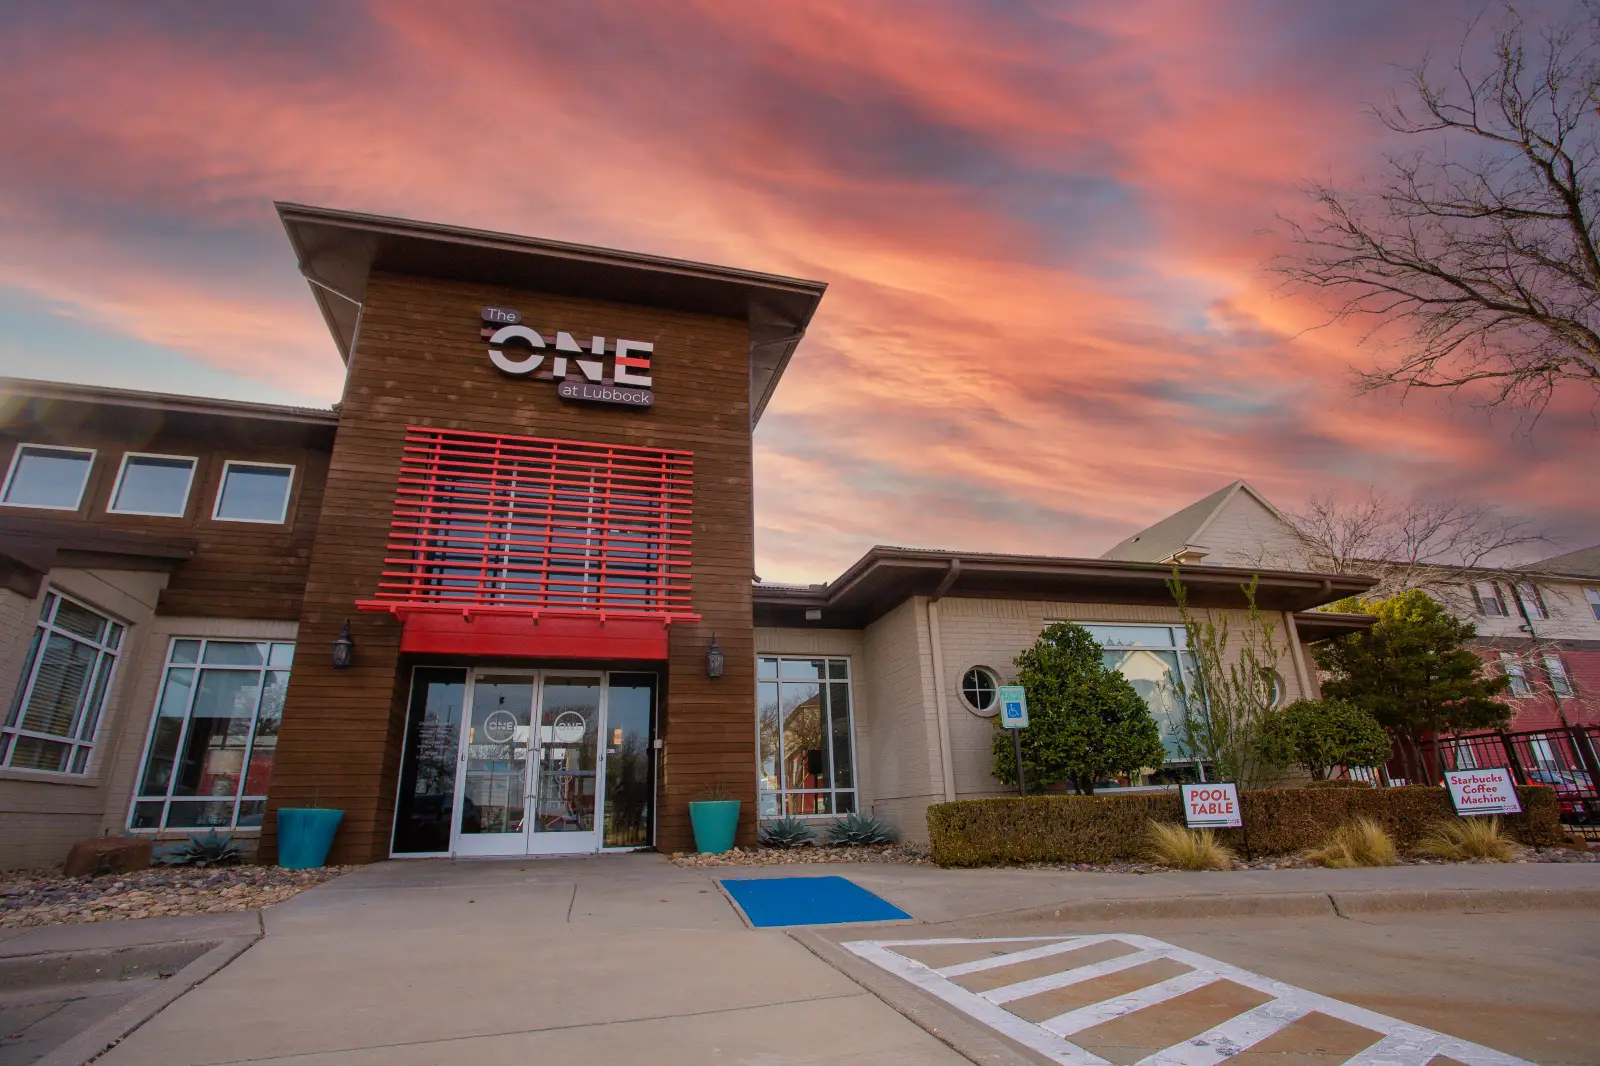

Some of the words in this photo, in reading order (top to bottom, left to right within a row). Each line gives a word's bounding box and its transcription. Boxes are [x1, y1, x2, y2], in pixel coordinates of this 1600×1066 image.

[487, 308, 516, 322] The
[488, 325, 654, 387] ONE
[562, 385, 578, 397] at
[583, 386, 650, 404] Lubbock
[489, 720, 514, 731] ONE
[558, 722, 582, 731] ONE
[1450, 774, 1503, 785] Starbucks
[1462, 784, 1498, 794] Coffee
[1190, 789, 1231, 801] POOL
[1461, 794, 1507, 805] Machine
[1190, 802, 1234, 815] TABLE
